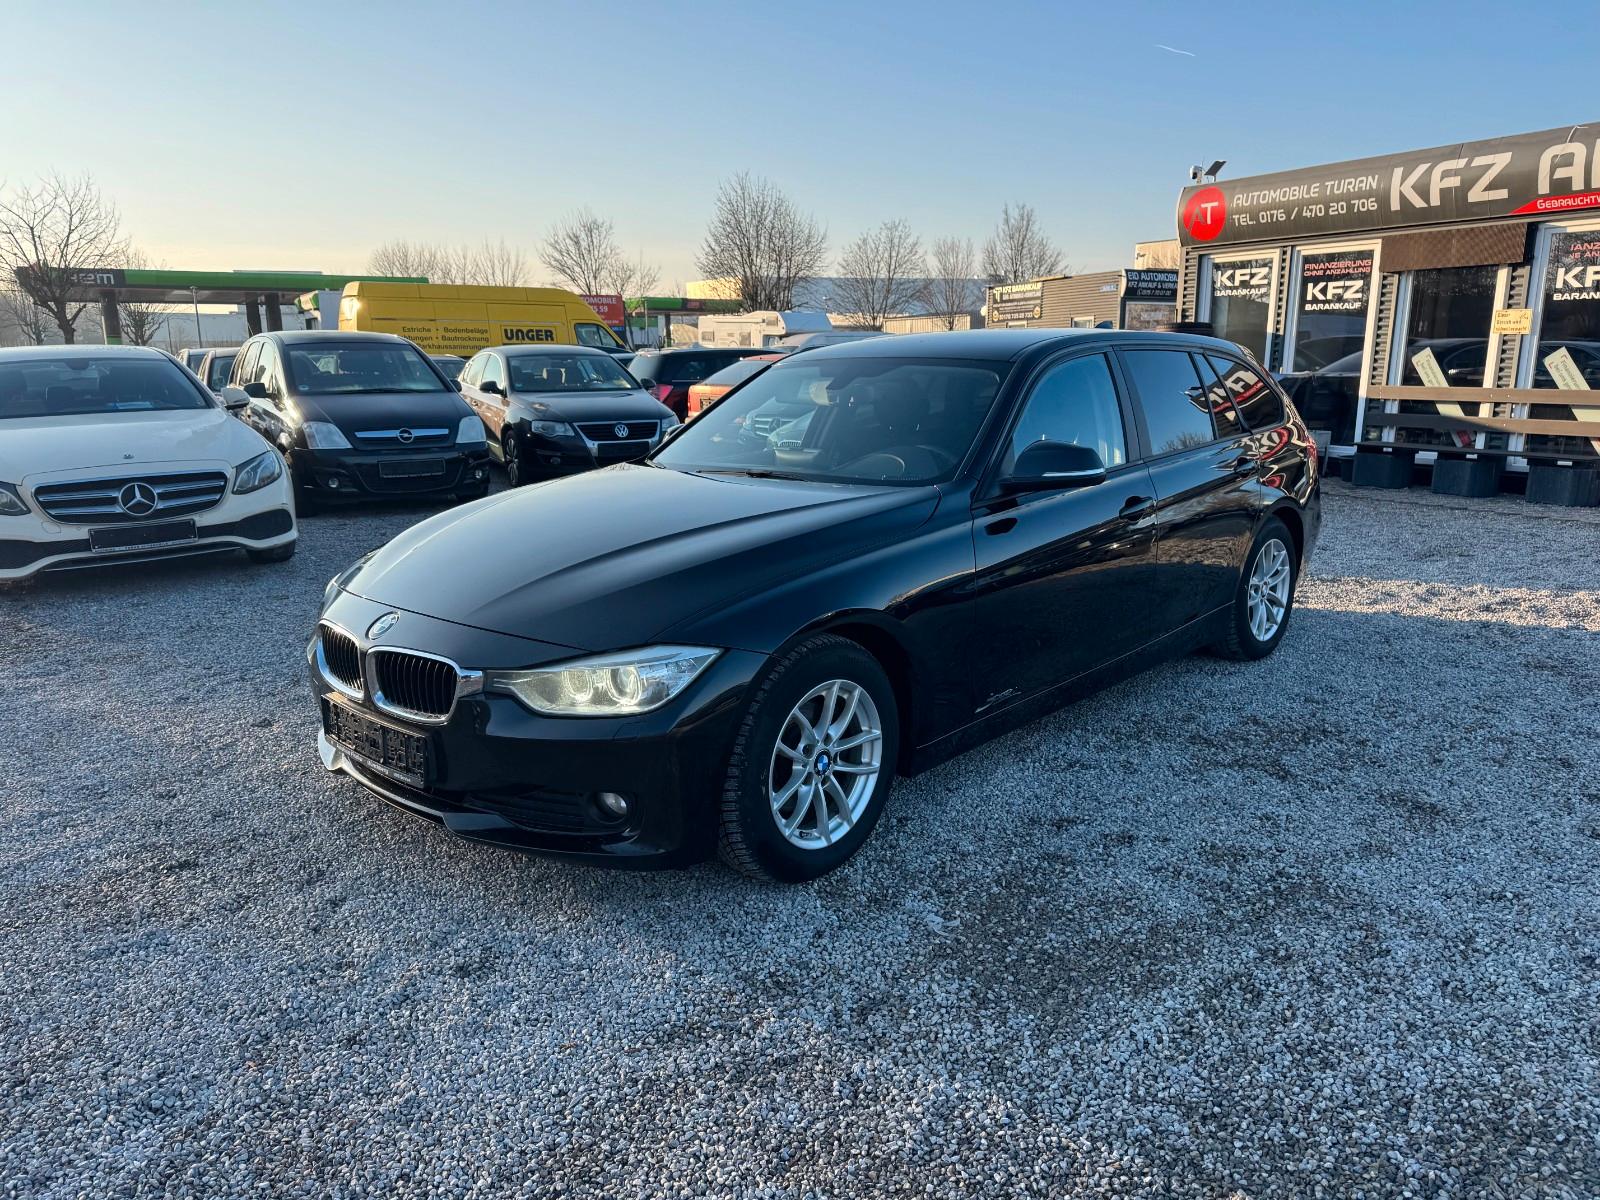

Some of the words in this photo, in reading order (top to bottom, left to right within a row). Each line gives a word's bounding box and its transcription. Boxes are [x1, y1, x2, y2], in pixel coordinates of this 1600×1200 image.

[1390, 152, 1512, 212] KFZ
[1233, 182, 1320, 208] AUTOMOBILE
[1325, 174, 1379, 196] TURAN
[1232, 213, 1256, 226] TEL.
[1259, 209, 1286, 223] 0176
[1302, 204, 1325, 218] 470
[1328, 201, 1347, 215] 20
[1350, 197, 1378, 213] 706
[1303, 268, 1325, 277] OHNE
[1304, 259, 1372, 271] FINANZIERUNG
[1216, 267, 1269, 288] KFZ
[1214, 287, 1268, 297] BARANKAUF
[1306, 279, 1364, 301] KFZ
[584, 296, 617, 305] OMOBILE
[1304, 301, 1362, 311] BARANKAUF
